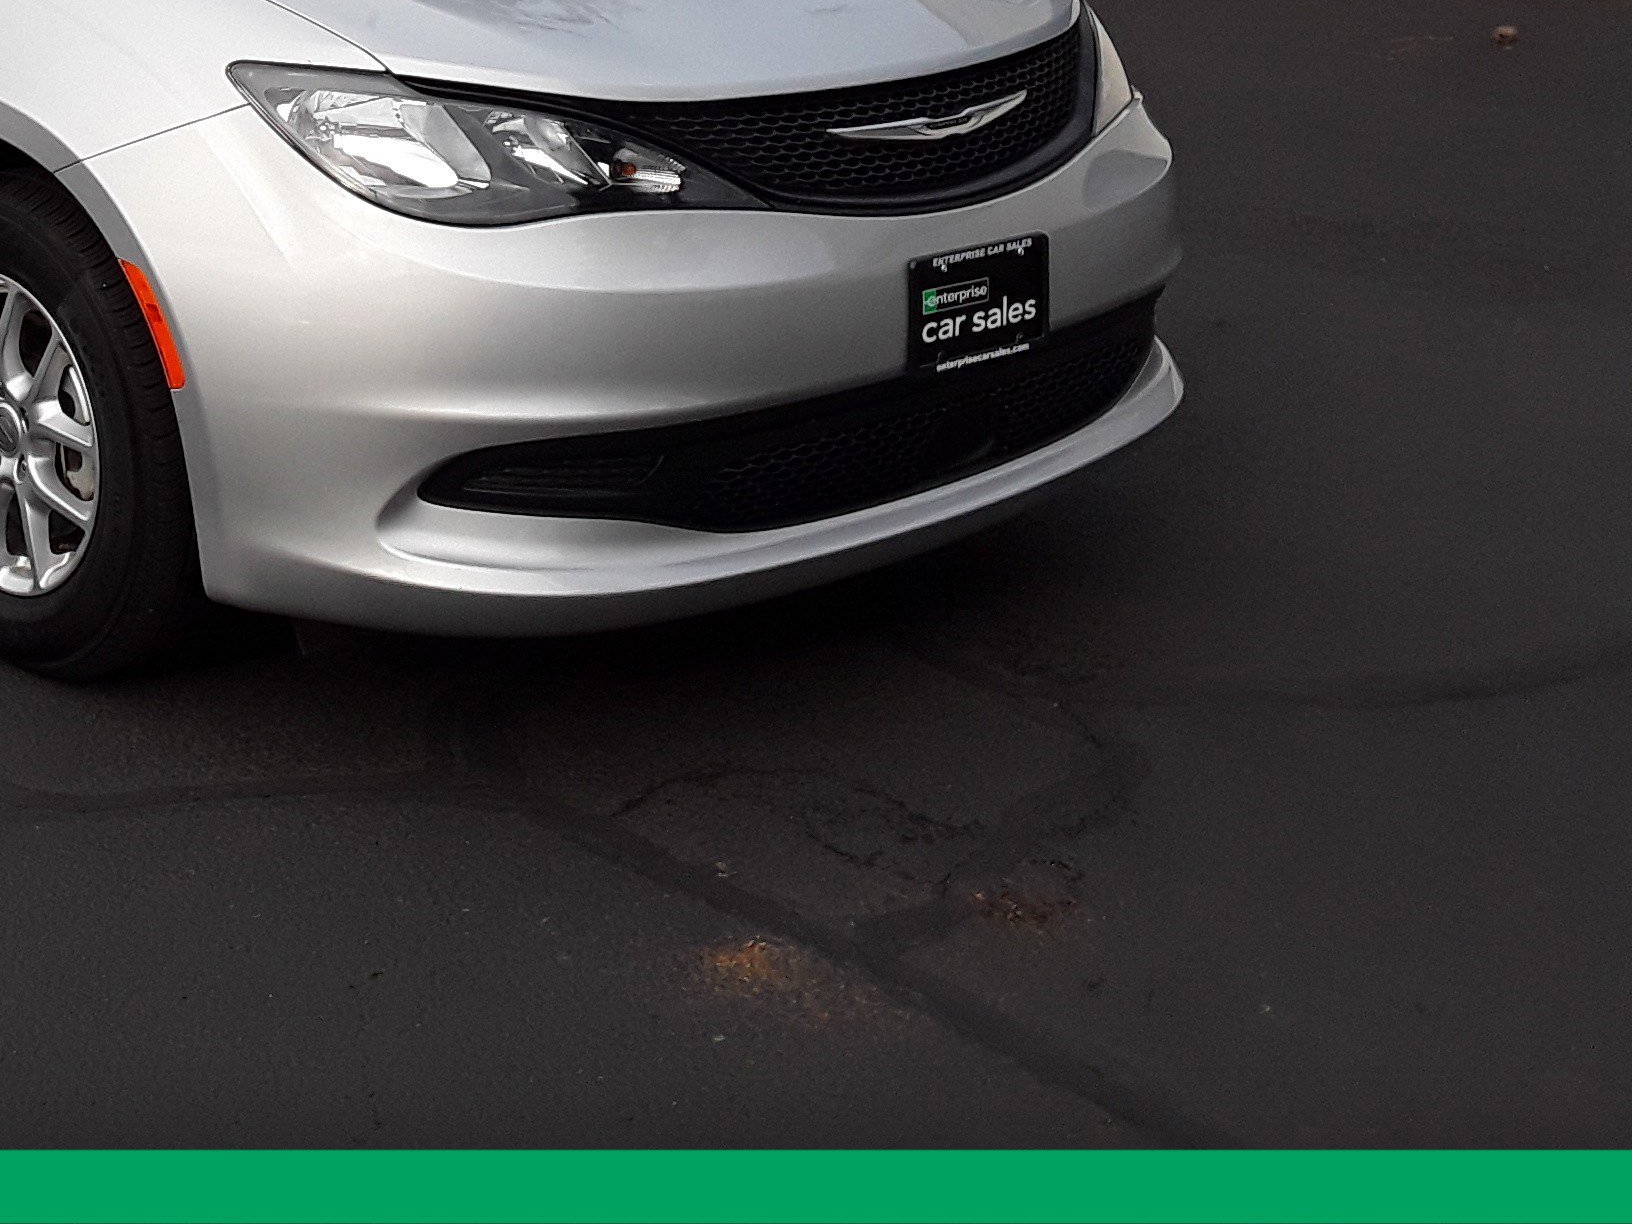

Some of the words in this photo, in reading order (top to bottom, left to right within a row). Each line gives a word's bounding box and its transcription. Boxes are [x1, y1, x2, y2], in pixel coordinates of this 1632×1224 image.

[932, 247, 986, 268] ENTERPRISE
[987, 243, 1005, 256] CAR
[1006, 237, 1033, 252] SALES
[924, 285, 988, 307] enterprise
[922, 314, 967, 343] car
[971, 295, 1037, 333] sales
